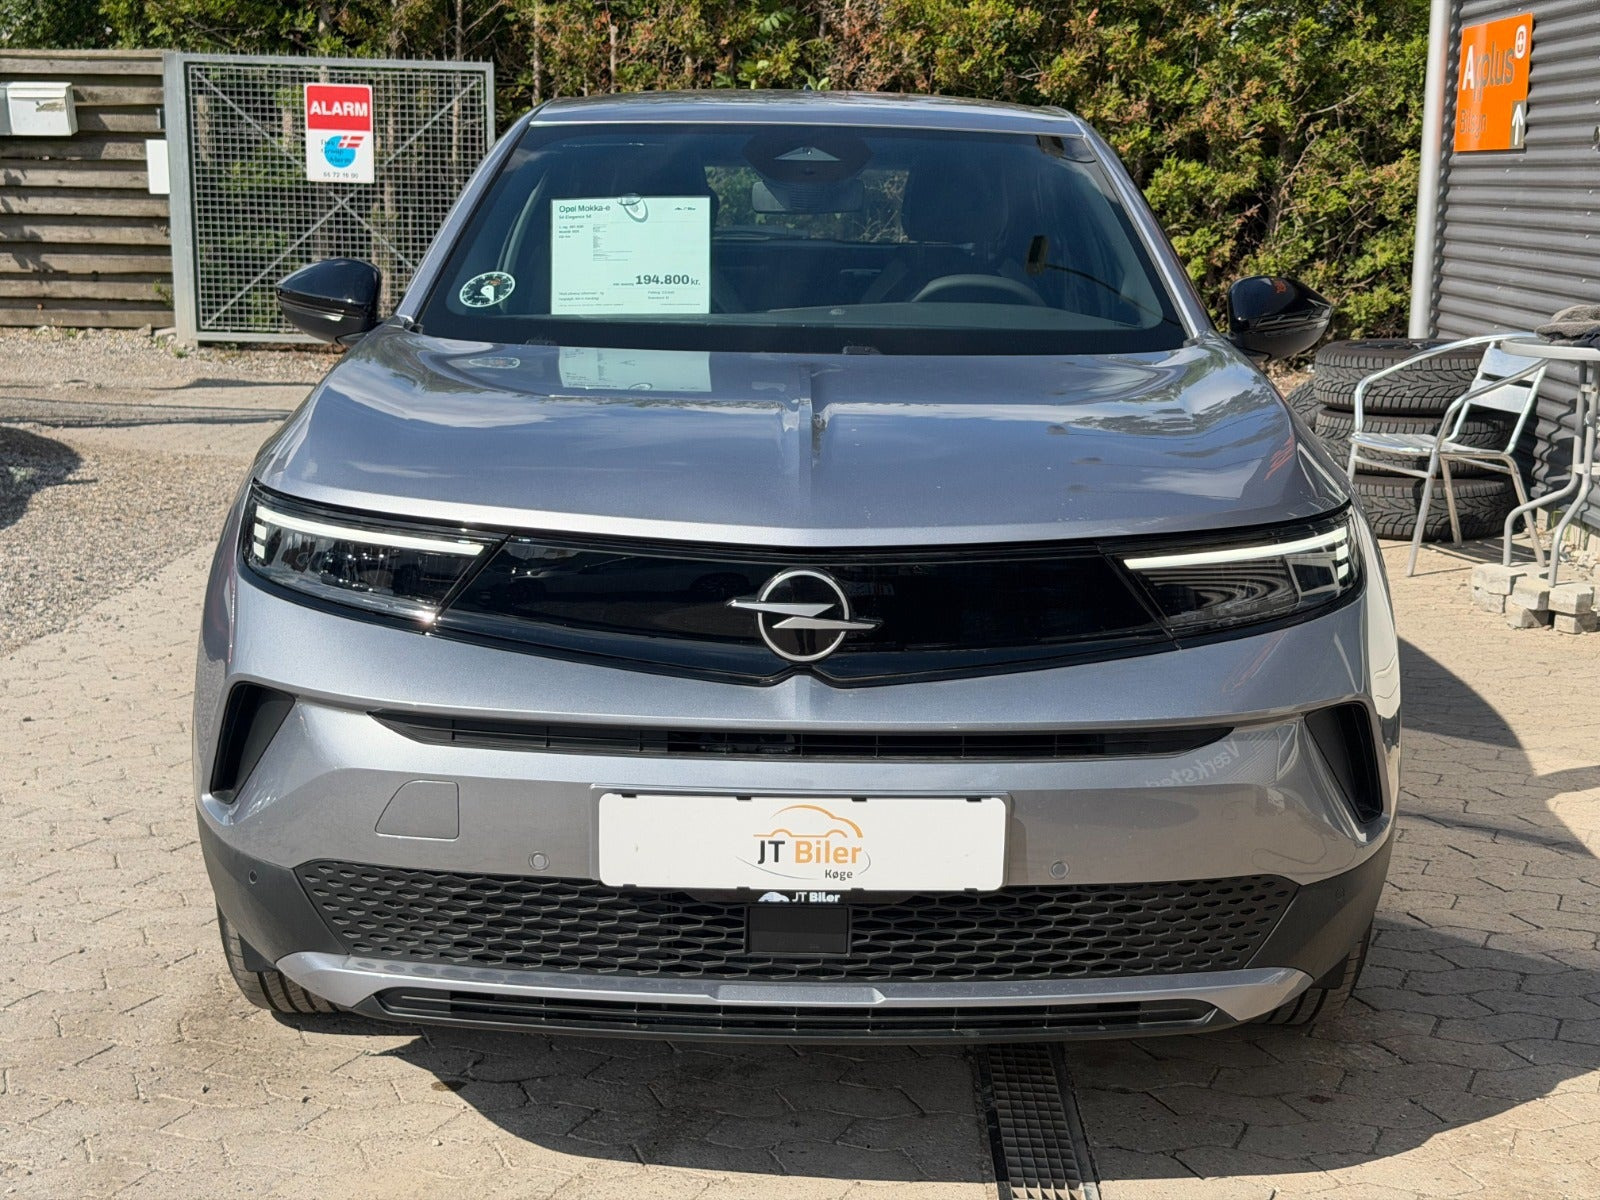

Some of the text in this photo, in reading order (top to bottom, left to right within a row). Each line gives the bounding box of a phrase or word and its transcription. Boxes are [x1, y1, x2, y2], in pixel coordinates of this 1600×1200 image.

[1462, 42, 1514, 102] Applus
[310, 100, 368, 117] ALARM
[559, 204, 611, 213] Opel Mokka-e
[635, 274, 690, 285] 194.800
[690, 277, 701, 286] kr.
[757, 840, 862, 865] JT Biler
[824, 869, 853, 881] Køge
[792, 892, 841, 903] JT Biler
